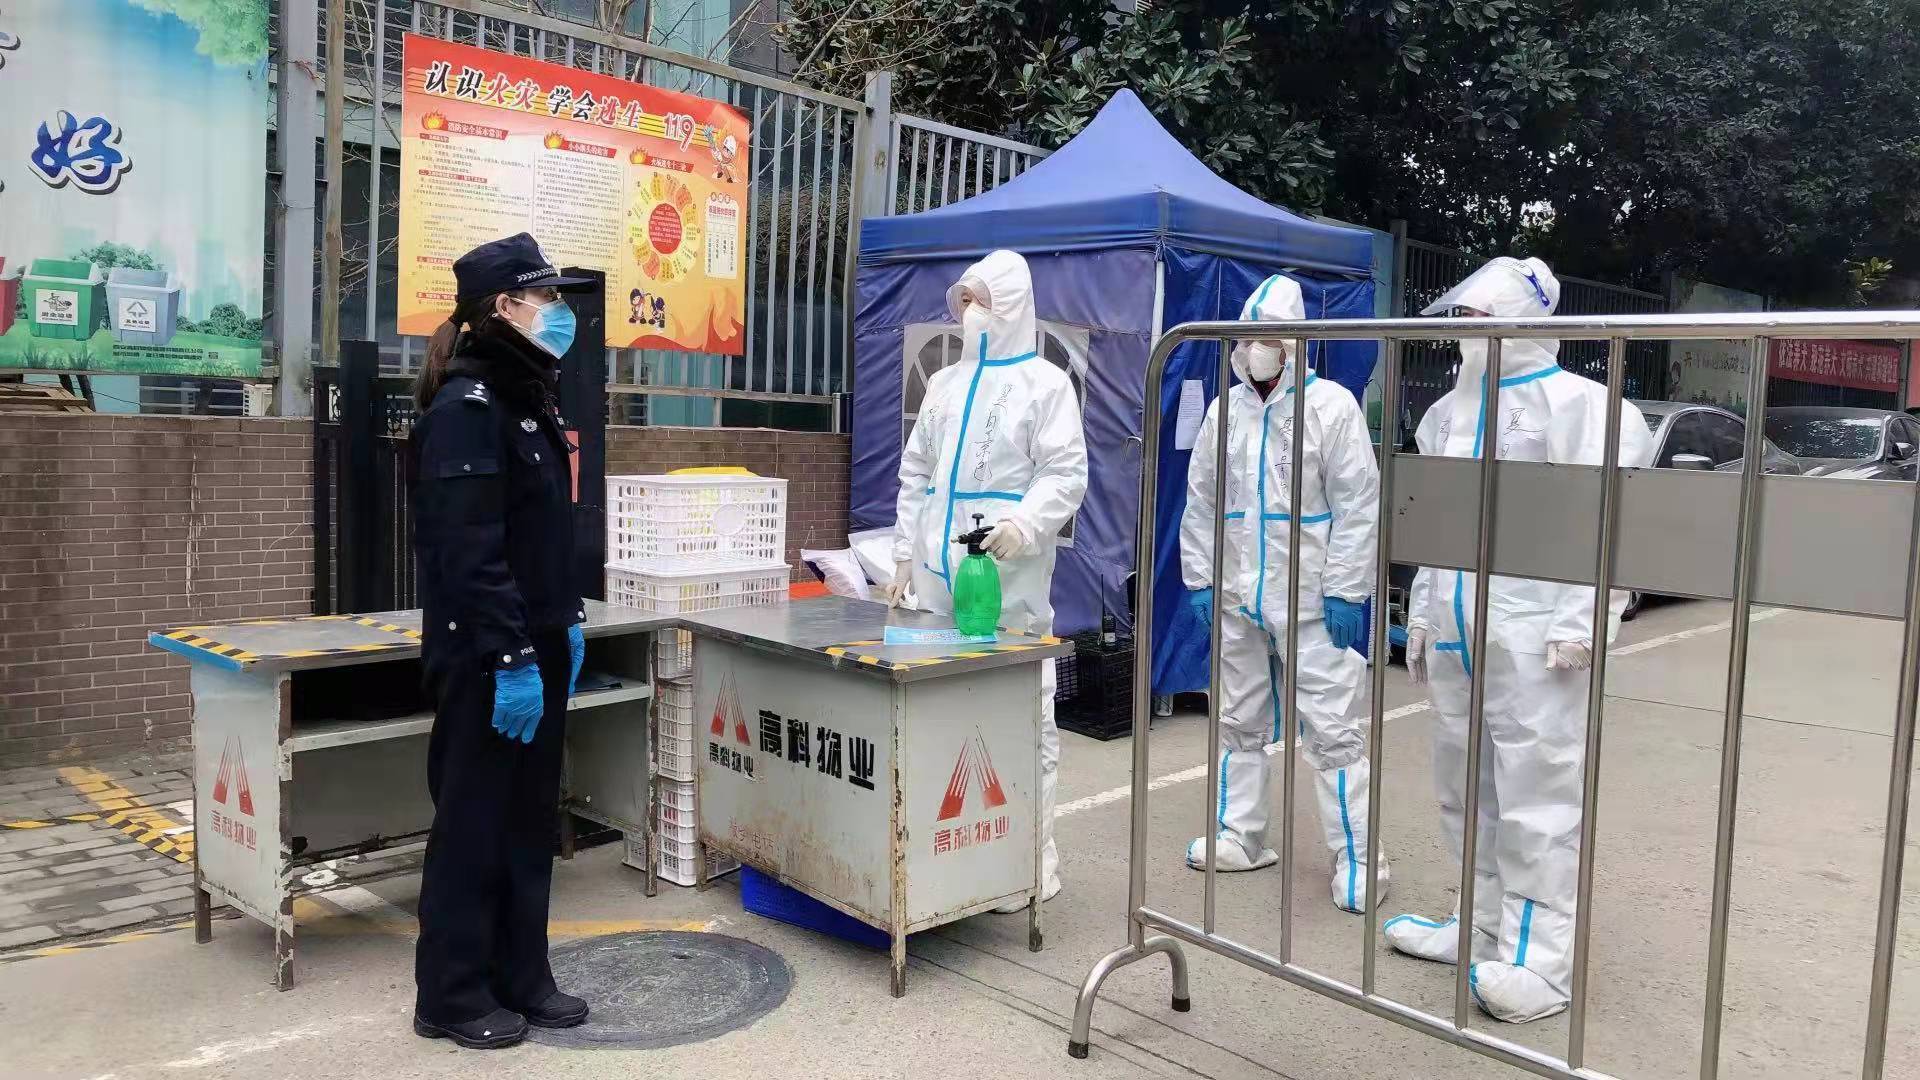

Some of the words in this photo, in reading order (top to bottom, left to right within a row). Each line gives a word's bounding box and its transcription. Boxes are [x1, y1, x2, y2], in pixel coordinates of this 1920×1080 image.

[424, 60, 540, 112] 认识火灾
[548, 86, 645, 129] 学会逃生
[663, 112, 696, 150] 119
[30, 109, 130, 191] 好
[709, 742, 754, 778] 高科物业
[758, 710, 875, 791] 高科物业
[210, 808, 257, 852] 高科物业
[934, 815, 1011, 855] 高科物业
